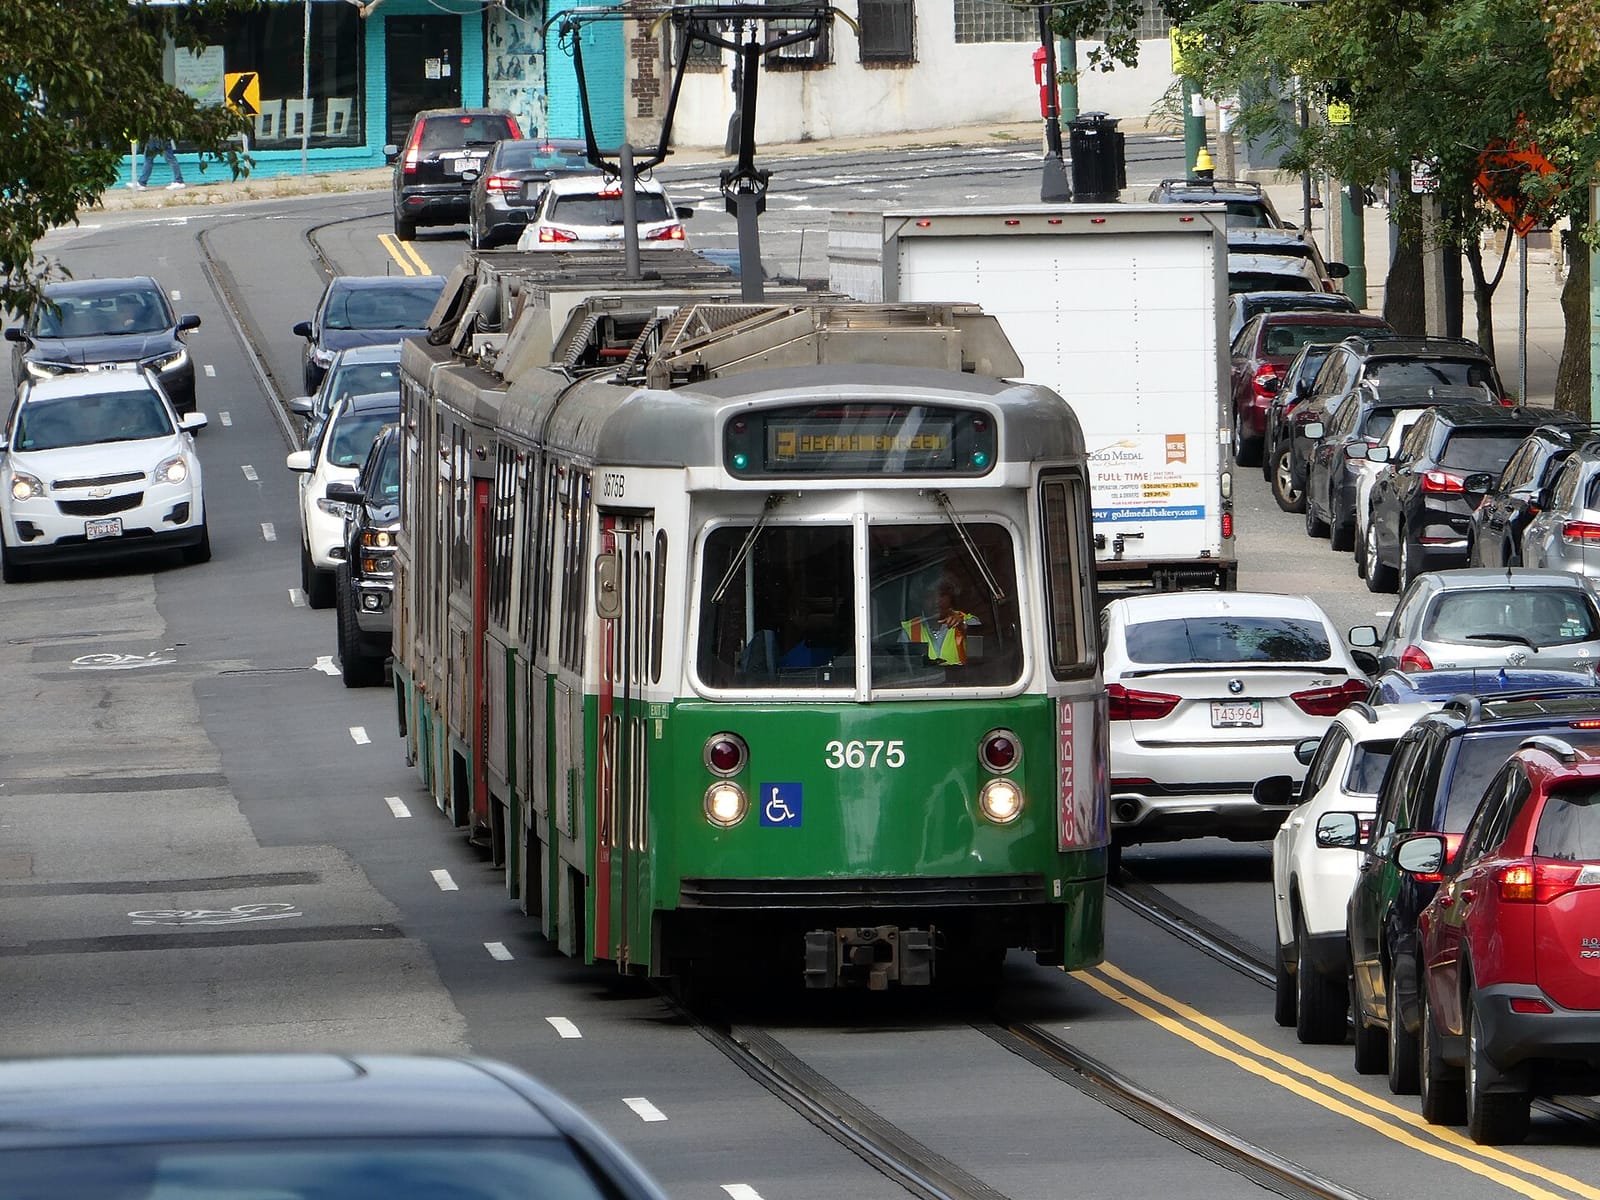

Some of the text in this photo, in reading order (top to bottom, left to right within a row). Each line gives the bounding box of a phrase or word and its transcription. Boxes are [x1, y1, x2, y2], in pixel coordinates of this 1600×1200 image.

[801, 434, 860, 451] HEATH
[872, 433, 948, 450] STREET
[1087, 450, 1144, 461] GOLD MEDAL
[1098, 472, 1122, 481] FULL
[1124, 472, 1149, 481] TIME
[1092, 508, 1198, 520] PPLY goldmedalbakery.com
[824, 739, 906, 769] 3675
